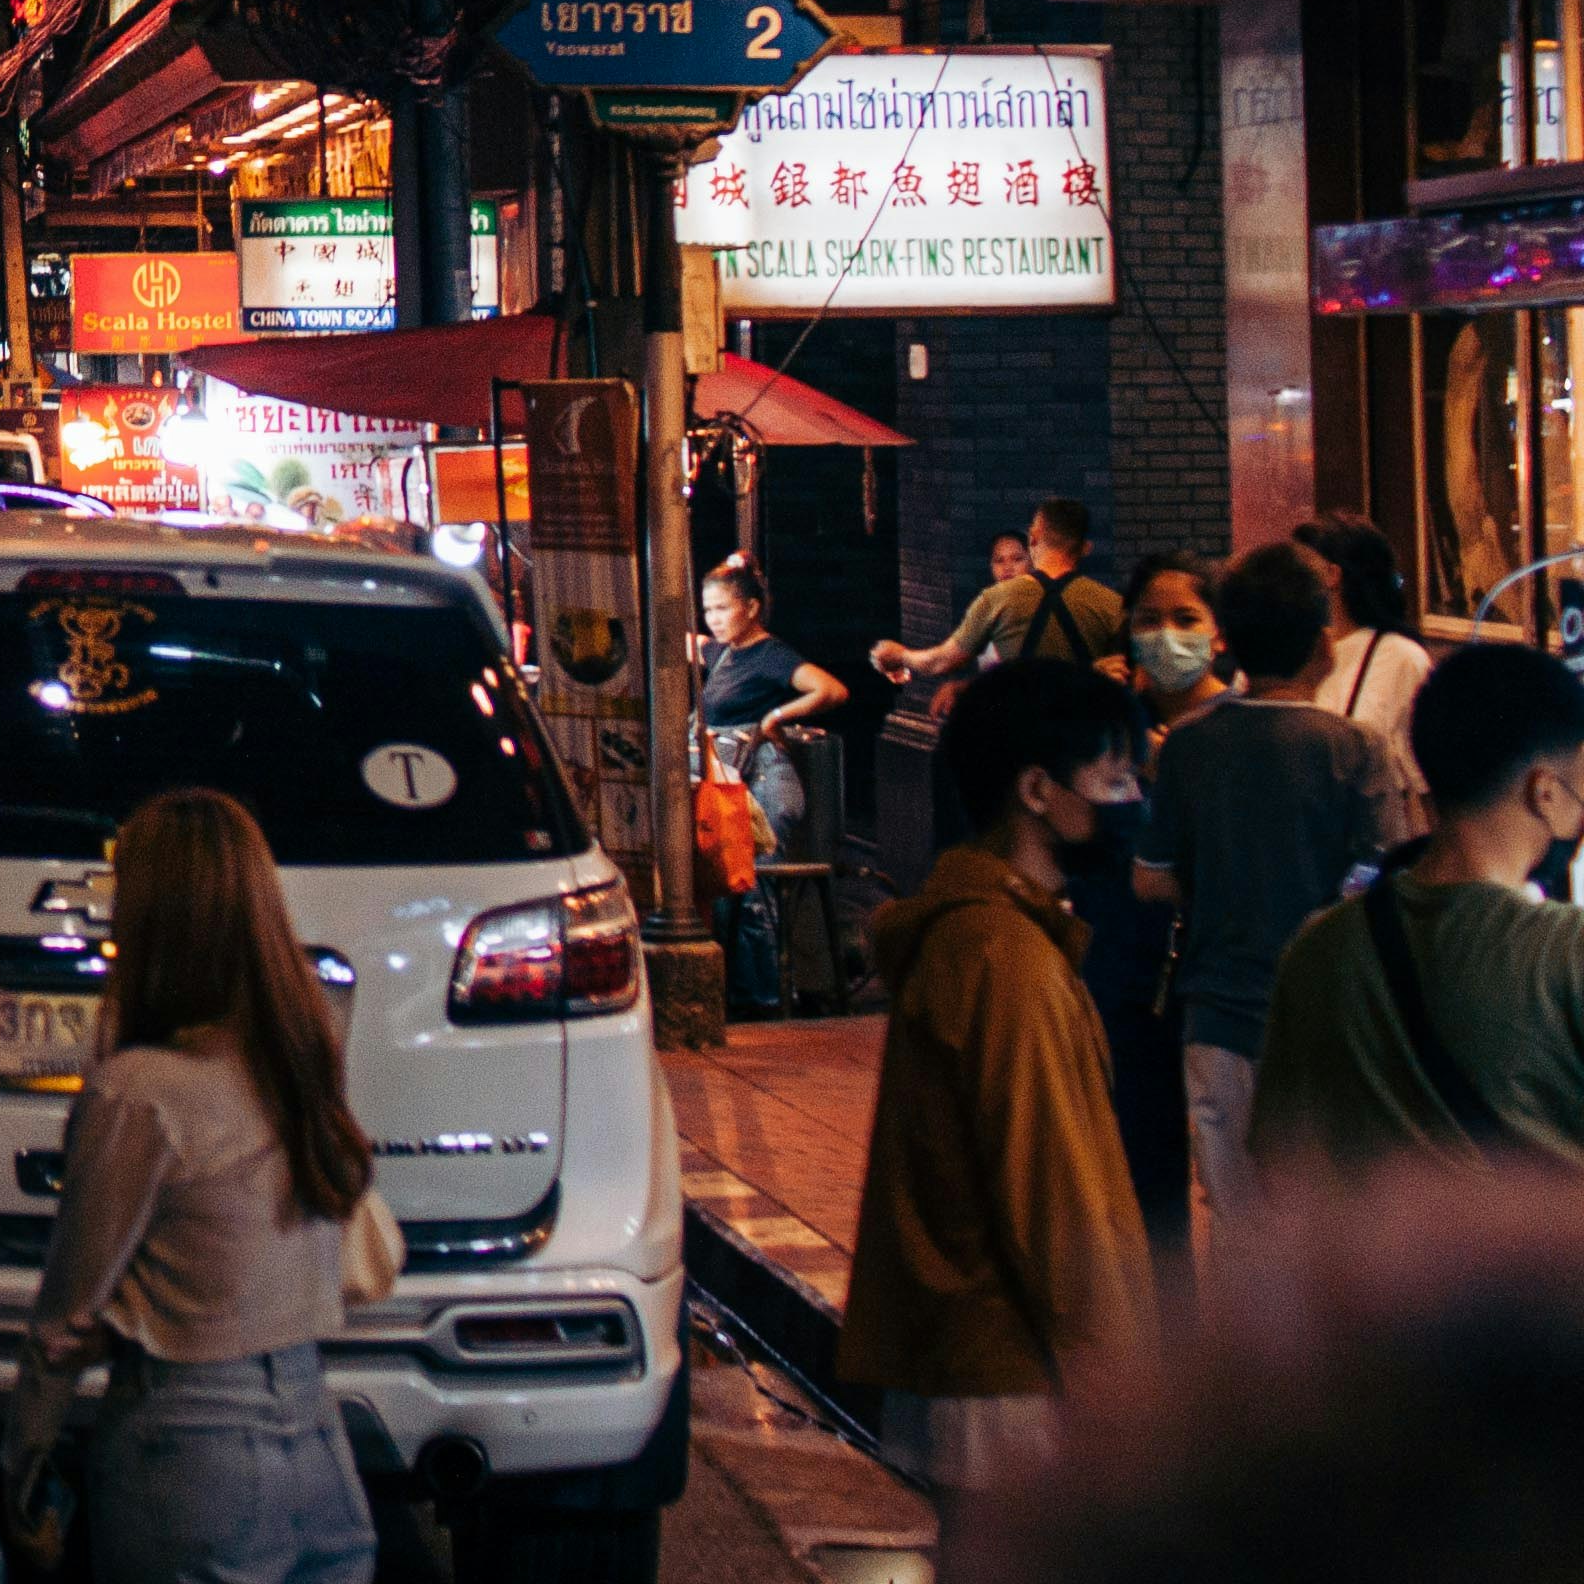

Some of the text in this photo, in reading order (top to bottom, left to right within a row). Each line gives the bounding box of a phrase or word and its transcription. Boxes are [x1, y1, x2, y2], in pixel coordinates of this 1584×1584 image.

[540, 0, 783, 59] เยาวราช 2
[546, 41, 626, 56] Yaowarat
[746, 239, 818, 279] SCALA
[825, 237, 954, 278] SHARK-FINS
[962, 236, 1105, 276] RESTAURANT
[82, 310, 233, 333] Scala Hostel
[250, 310, 295, 328] CHINA
[298, 310, 344, 327] TOWN
[388, 751, 426, 800] T
